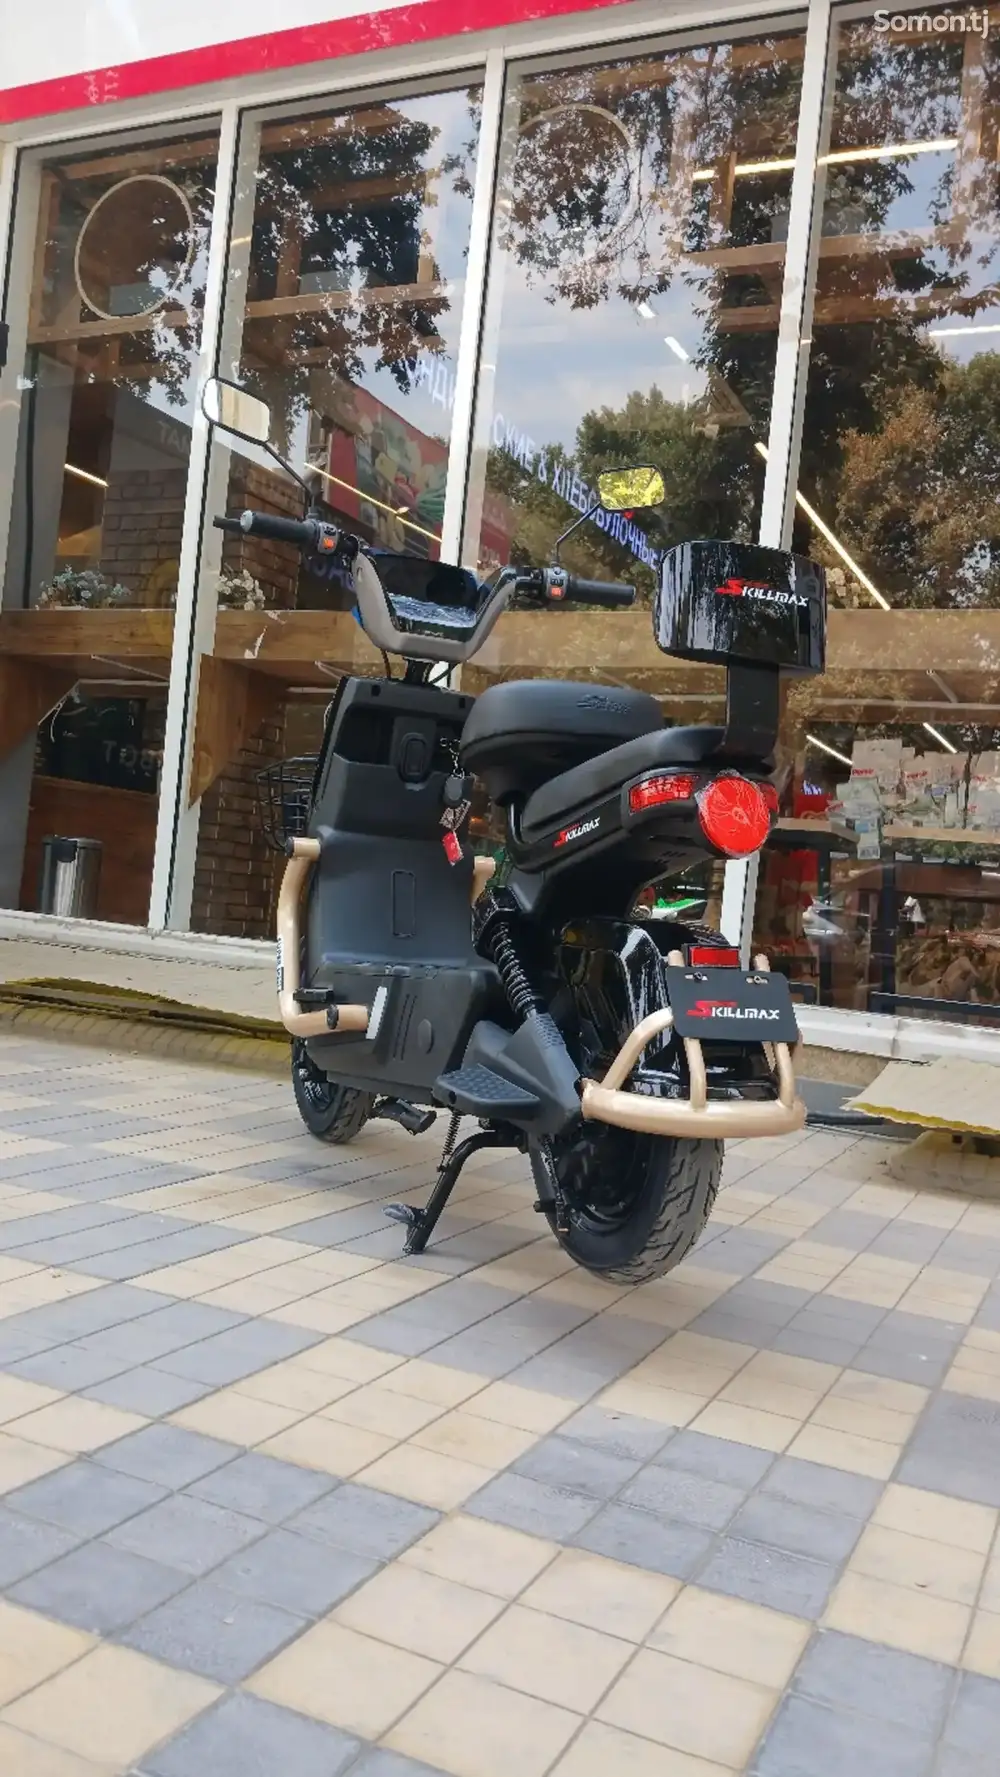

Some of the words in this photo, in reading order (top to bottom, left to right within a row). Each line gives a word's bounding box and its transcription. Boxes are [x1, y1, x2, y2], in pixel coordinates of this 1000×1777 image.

[714, 577, 810, 607] SKILLMAX
[553, 816, 601, 849] SKILLMAX
[686, 1000, 780, 1020] SKILLMAX
